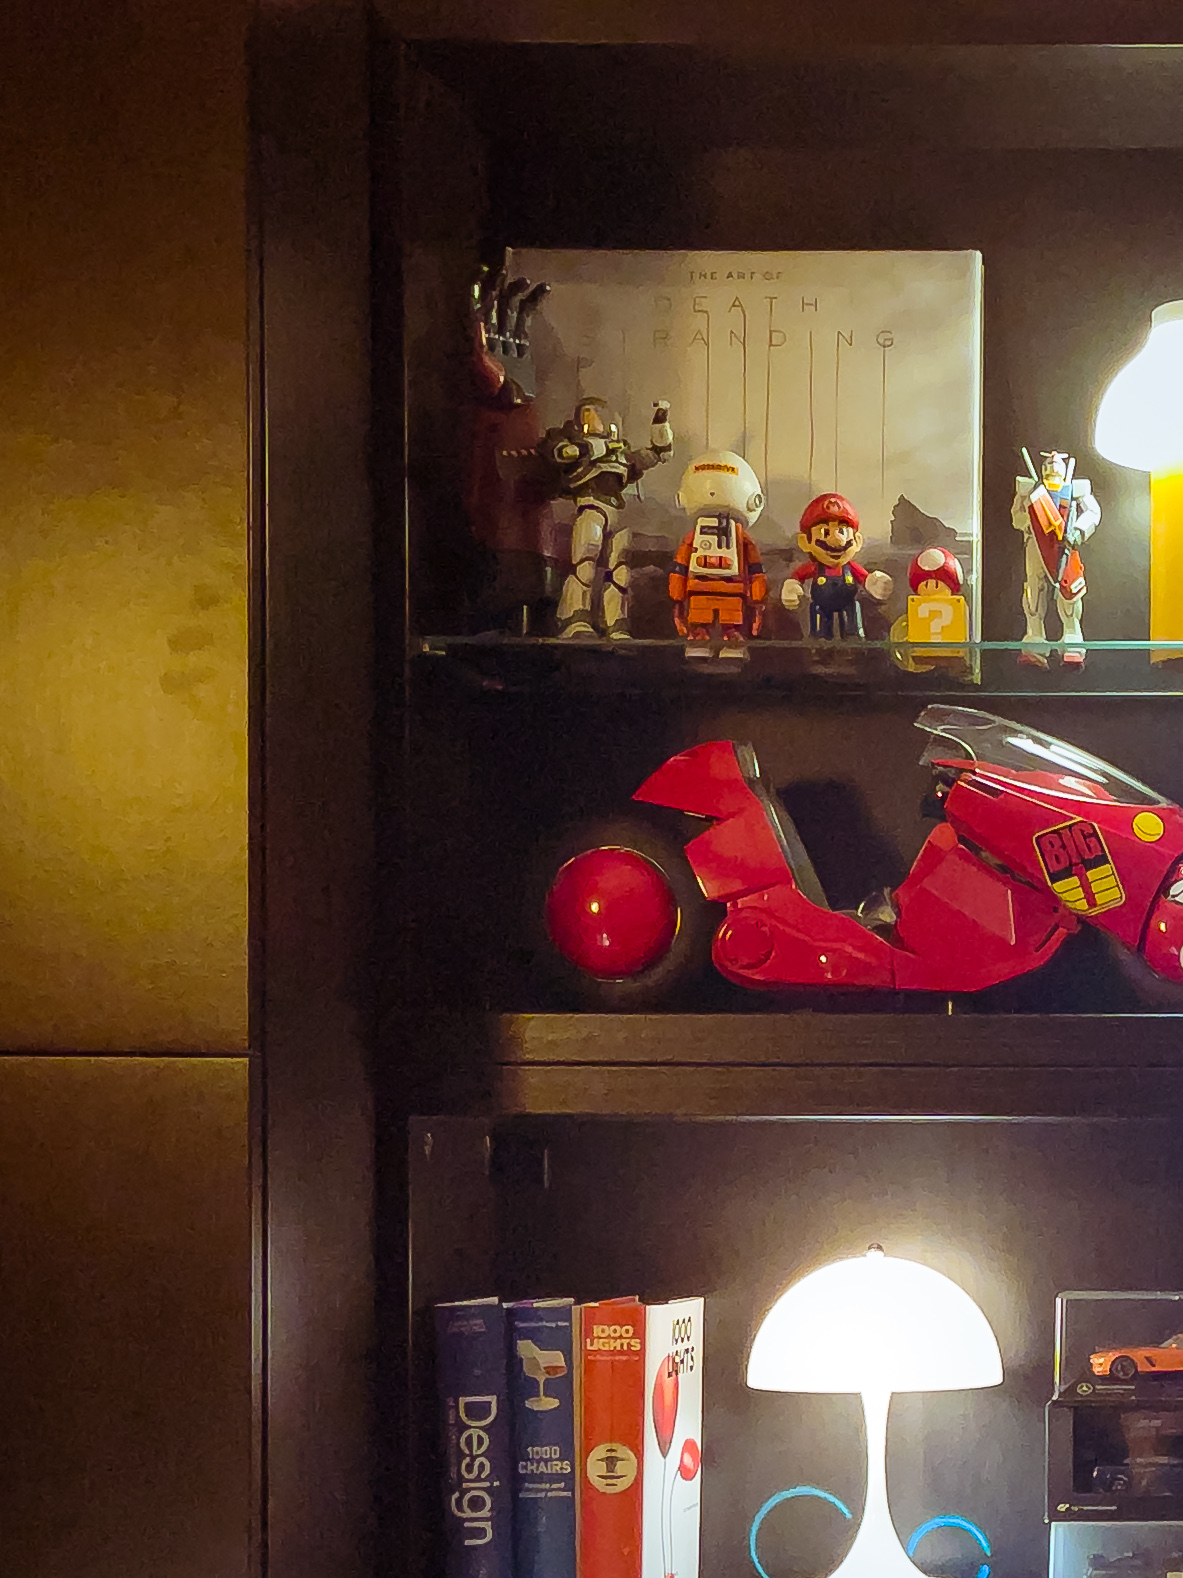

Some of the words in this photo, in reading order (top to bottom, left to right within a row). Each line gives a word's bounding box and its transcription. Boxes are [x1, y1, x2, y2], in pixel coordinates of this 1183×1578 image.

[688, 271, 718, 281] THE
[726, 271, 756, 281] ART
[1045, 820, 1101, 874] BIG
[593, 1324, 634, 1338] 1000
[586, 1337, 642, 1352] LIGHTS
[526, 1446, 560, 1459] 1000
[451, 1394, 500, 1547] Design
[518, 1460, 572, 1475] CHAIRS
